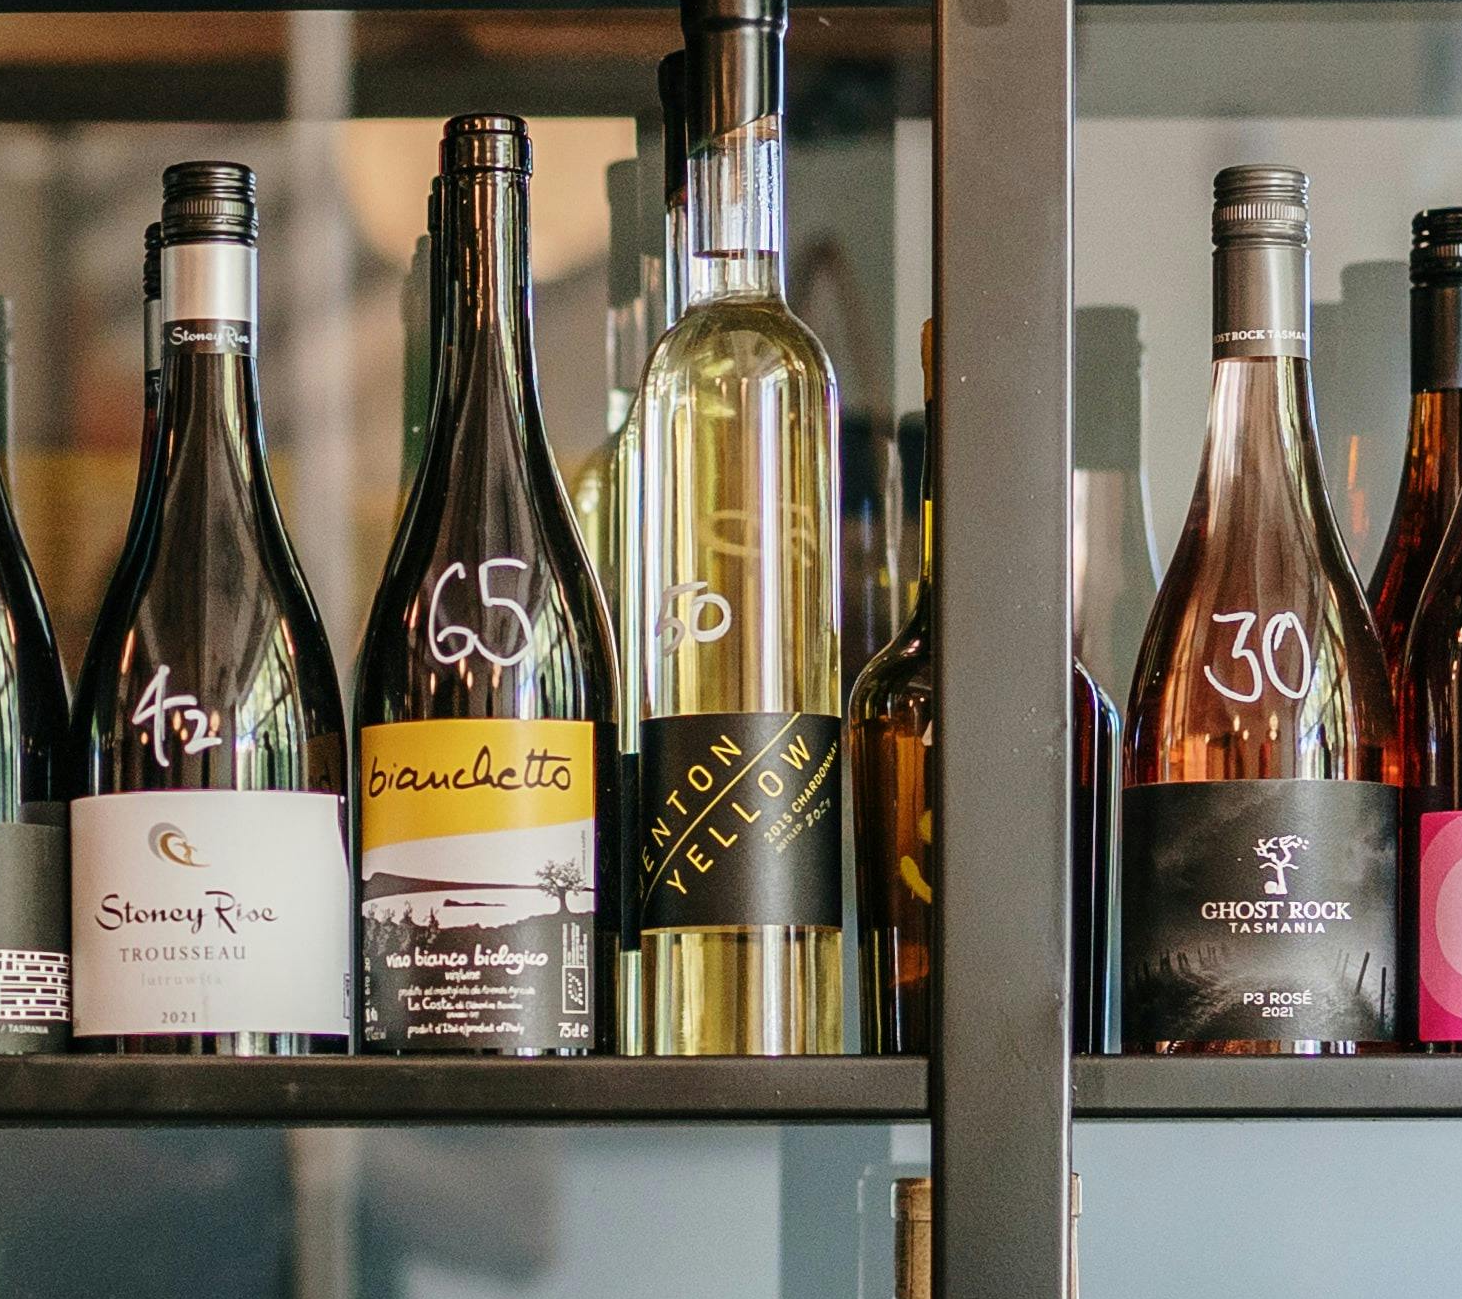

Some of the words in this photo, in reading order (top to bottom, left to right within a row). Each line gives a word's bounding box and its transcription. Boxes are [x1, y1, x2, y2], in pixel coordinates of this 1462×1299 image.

[428, 557, 535, 667] 65
[1203, 609, 1312, 704] 30
[132, 663, 222, 768] 42
[368, 745, 573, 799] bianchetto
[665, 733, 811, 897] YELLOW
[95, 892, 206, 934] Stoney
[204, 890, 279, 934] Rise
[1201, 901, 1285, 920] GHOST
[1289, 901, 1351, 920] ROCK
[1228, 922, 1326, 934] TASMANIA
[119, 945, 247, 962] TROUSSEAU
[385, 950, 412, 969] vino
[414, 947, 468, 968] bianco
[473, 944, 549, 976] biologico
[1243, 992, 1265, 1005] P3
[1269, 989, 1312, 1005] ROSÉ
[1261, 1007, 1294, 1018] 2021
[160, 1011, 198, 1024] 2021
